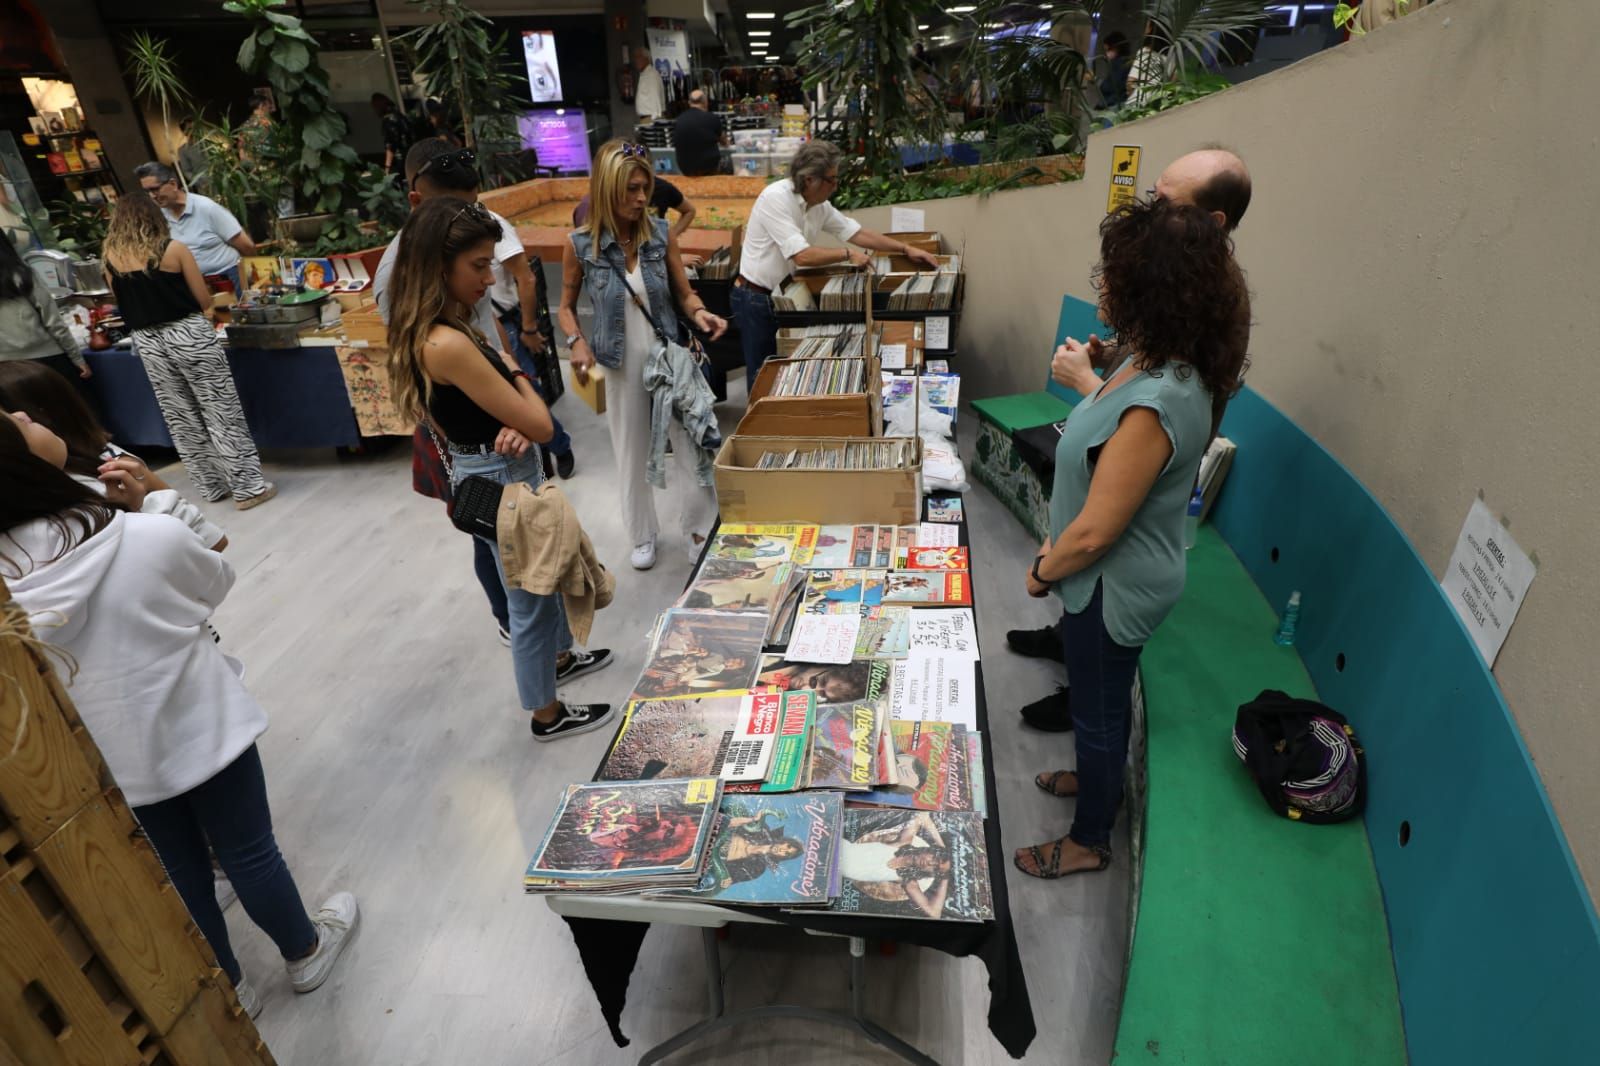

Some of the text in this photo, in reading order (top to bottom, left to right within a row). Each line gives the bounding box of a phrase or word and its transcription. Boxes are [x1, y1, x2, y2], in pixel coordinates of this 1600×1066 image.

[1113, 175, 1134, 186] AVISO
[1486, 538, 1507, 569] OFERTAS:
[893, 669, 904, 699] REVISTAS
[948, 679, 960, 706] OFERTAS:
[753, 705, 768, 734] Negro
[764, 702, 778, 733] Blanco
[781, 694, 809, 737] SEMANA
[892, 705, 901, 714] 20
[726, 748, 741, 764] COLOR
[733, 741, 753, 776] FOTOGRAFIAS
[748, 741, 764, 766] PRIMERAS
[791, 803, 830, 897] Vibraciones
[850, 890, 860, 911] ALICE
